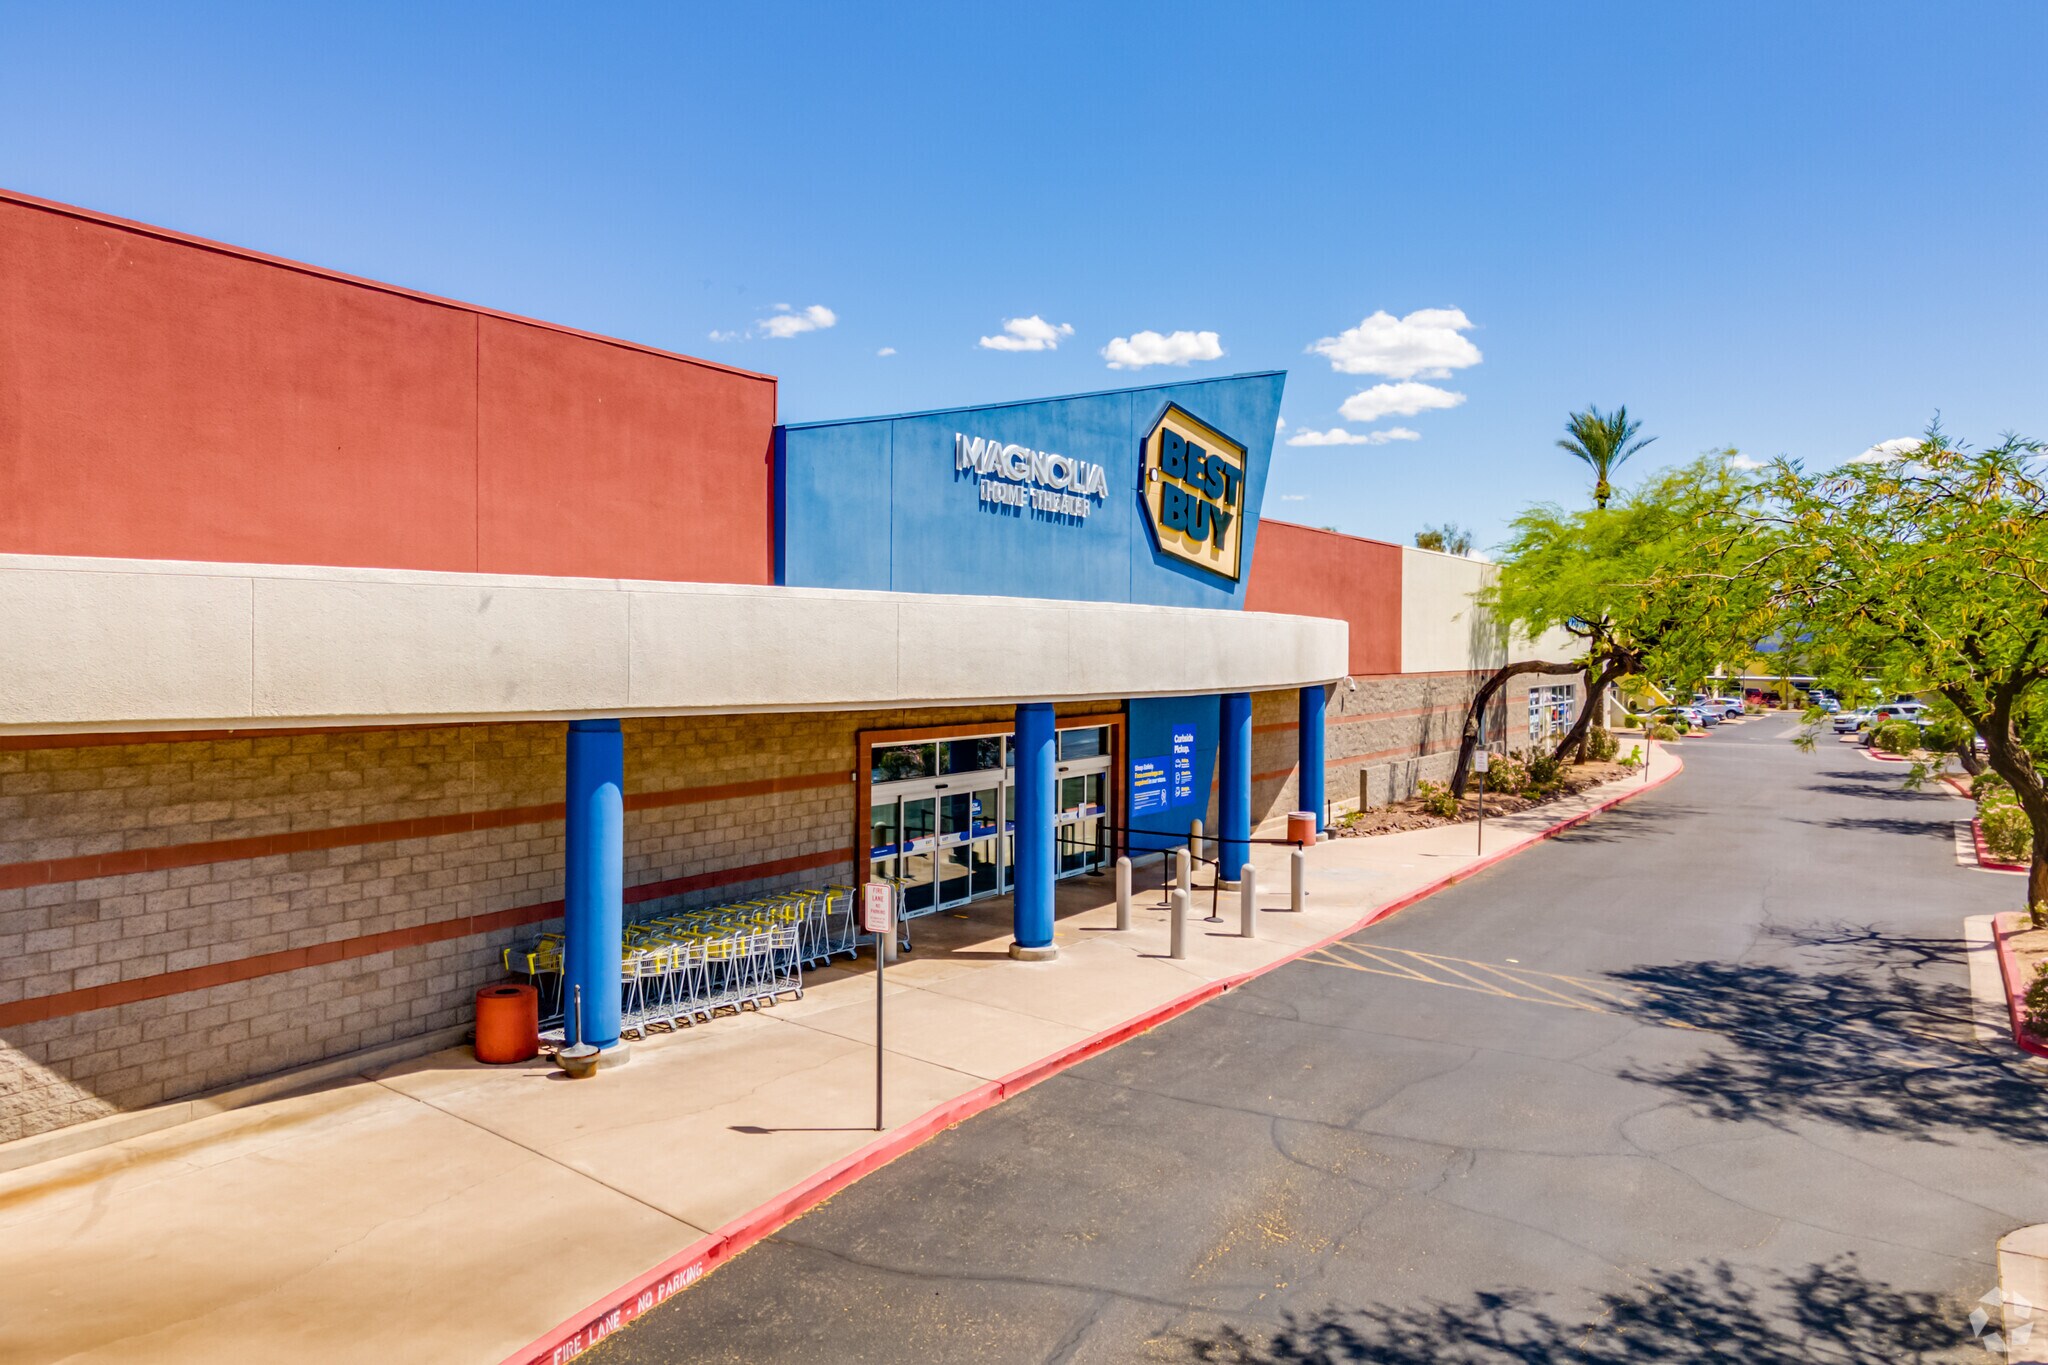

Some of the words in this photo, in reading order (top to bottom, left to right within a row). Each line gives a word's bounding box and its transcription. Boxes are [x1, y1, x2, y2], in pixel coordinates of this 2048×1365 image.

[955, 432, 1109, 499] MAGNOLIA
[980, 478, 1028, 507] HOME
[1030, 487, 1091, 518] THEATER
[1161, 427, 1242, 506] BEST
[1161, 481, 1234, 551] BUY
[1174, 734, 1193, 743] Curbside
[553, 1335, 582, 1365] FIRE
[588, 1309, 621, 1345] LANE
[637, 1291, 653, 1314] NO
[658, 1261, 703, 1302] PARKING
